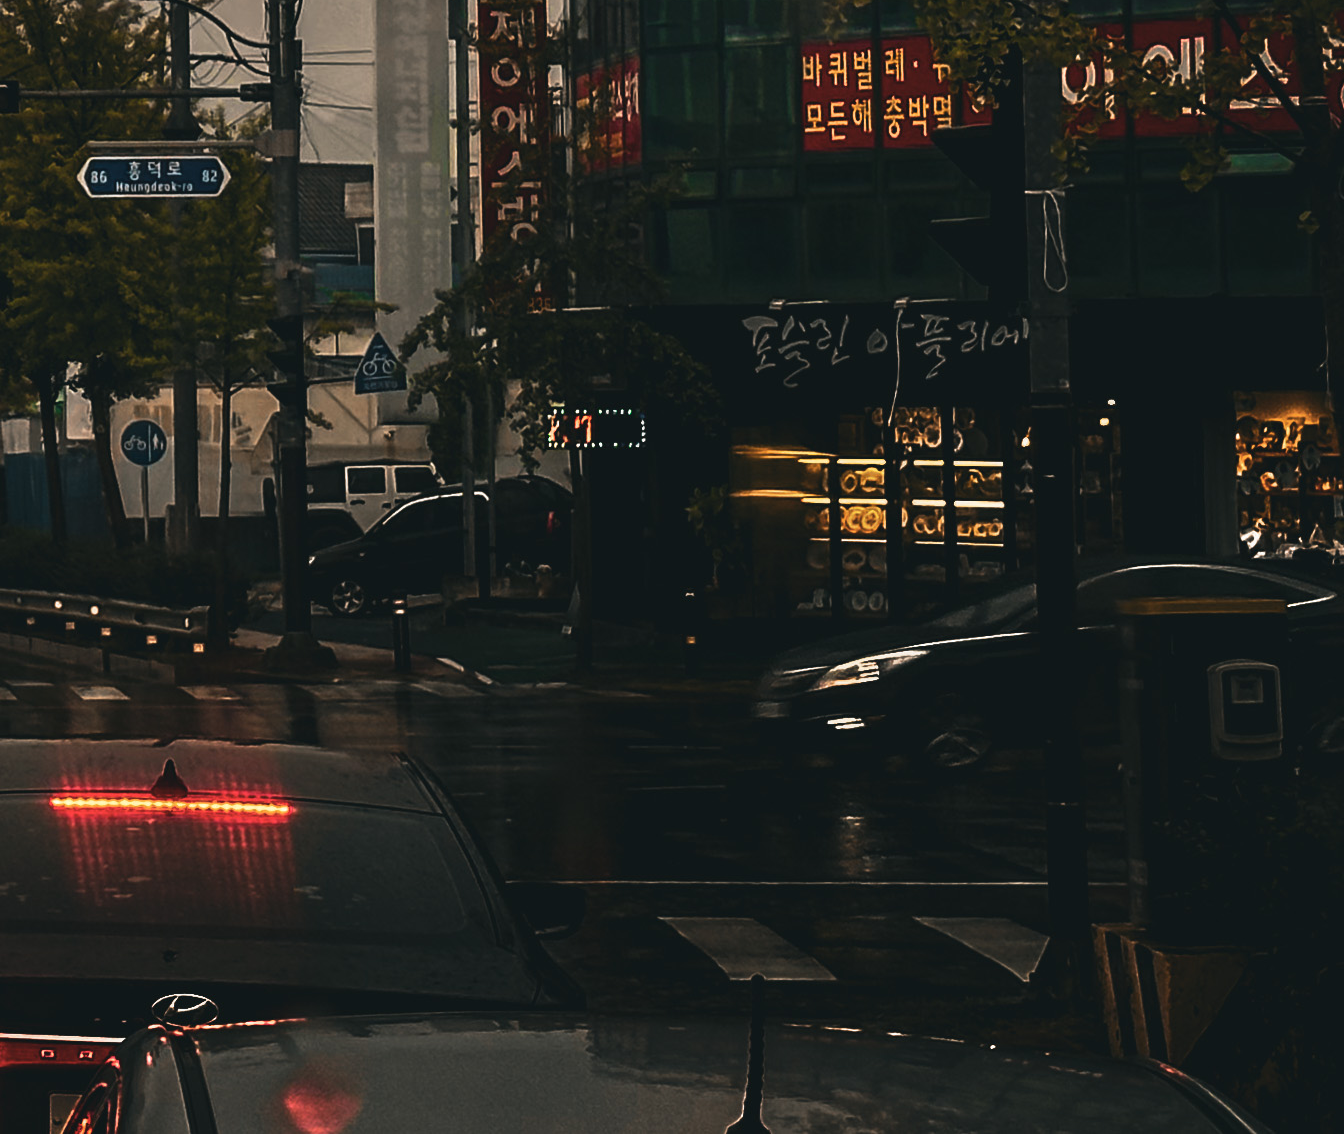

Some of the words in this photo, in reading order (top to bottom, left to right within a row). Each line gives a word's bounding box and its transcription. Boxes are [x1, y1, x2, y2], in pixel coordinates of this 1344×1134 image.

[90, 170, 108, 184] 86
[128, 161, 182, 181] 흥덕로
[201, 169, 218, 183] 82
[115, 181, 194, 194] Heungdeok-ro
[741, 314, 851, 388] 포슬린
